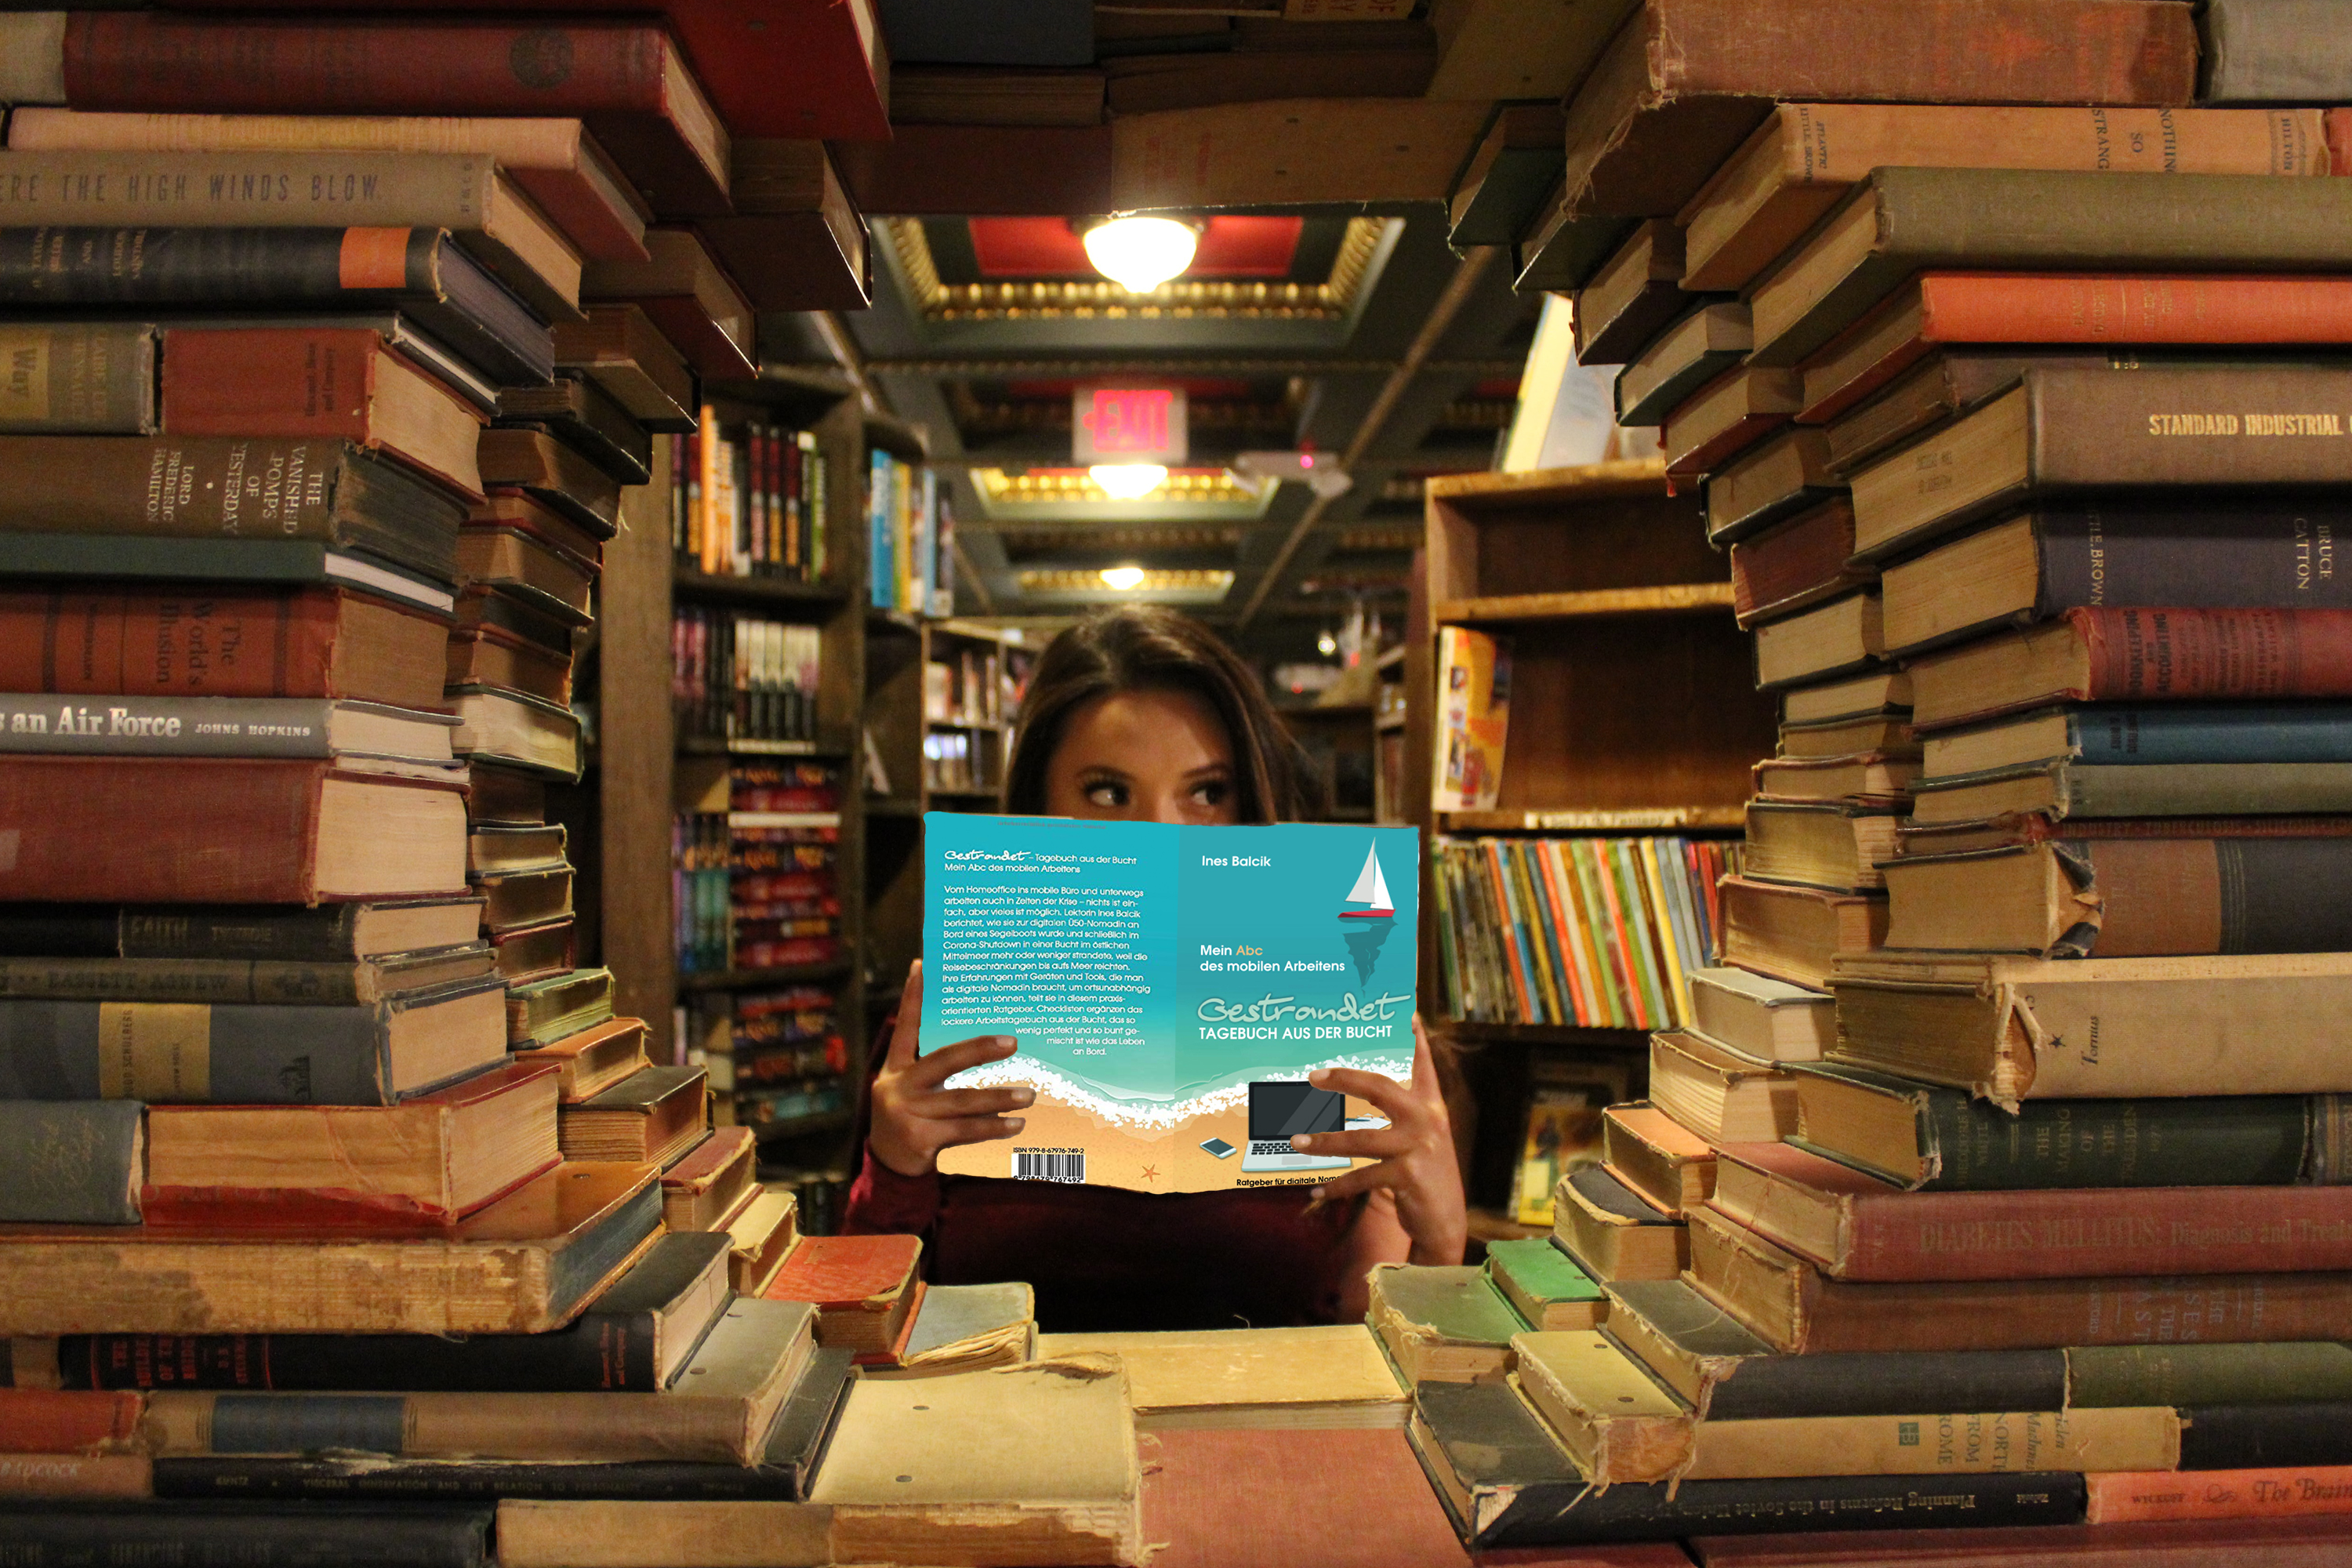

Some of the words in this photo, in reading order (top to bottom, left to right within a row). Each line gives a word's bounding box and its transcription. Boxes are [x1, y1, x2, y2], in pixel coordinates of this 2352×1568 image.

[2131, 132, 2143, 153] SO
[2281, 118, 2294, 171] HILTON
[63, 173, 106, 201] THE
[129, 173, 187, 201] HIGH
[209, 173, 289, 201] WINDS
[1093, 390, 1173, 452] EXIT
[2149, 414, 2238, 436] STANDARD
[2245, 414, 2344, 436] INDUSTRIAL
[147, 448, 167, 522] HAMILTON
[162, 451, 182, 521] FREDERIC
[179, 466, 194, 505] LORD
[223, 442, 251, 534] YESTERDAY
[246, 476, 260, 497] OF
[263, 456, 284, 519] POMPS
[283, 446, 307, 534] VANISHED
[307, 472, 323, 506] THE
[2293, 517, 2310, 590] CATTON
[2317, 524, 2333, 580] BRUCE
[2090, 549, 2104, 606] BROWN
[158, 604, 180, 682] Illusion
[189, 601, 214, 684] World's
[222, 617, 242, 665] The
[2154, 613, 2172, 692] ACCOUNTING
[10, 712, 49, 735] an
[54, 706, 103, 735] Air
[108, 706, 182, 737] Force
[194, 723, 240, 735] JOHNS
[248, 724, 311, 737] HOPKINS
[944, 850, 1032, 862] Gestrandet
[1035, 853, 1078, 863] Tagebuch
[1095, 855, 1111, 864] der
[1112, 856, 1137, 865] Bucht
[967, 863, 986, 872] Abc
[1040, 865, 1080, 873] Arbeitens
[1202, 855, 1228, 866] Ines
[1232, 855, 1272, 867] Balcik
[944, 885, 964, 894] Vom
[966, 885, 1016, 894] Homeoffice
[1029, 886, 1059, 895] mobile
[1099, 888, 1144, 898] unterwegs
[1007, 896, 1014, 905] in
[943, 919, 984, 927] berichtet,
[1029, 918, 1066, 928] digitalen
[1068, 918, 1126, 927] Ü50-Nomadin
[944, 908, 966, 916] fach,
[1025, 908, 1062, 917] möglich.
[1116, 909, 1141, 918] Balcik
[943, 930, 964, 938] Bord
[989, 929, 1036, 939] Segelboots
[1200, 945, 1232, 956] Mein
[1236, 945, 1263, 956] Abc
[1200, 960, 1223, 971] des
[1227, 960, 1280, 971] mobilen
[1283, 960, 1345, 971] Arbeitens
[1197, 992, 1411, 1022] Gestrandet
[122, 1010, 132, 1068] SCHULBERG
[1199, 1027, 1278, 1040] TAGEBUCH
[1282, 1027, 1311, 1040] AUS
[1315, 1026, 1342, 1039] DER
[1346, 1025, 1392, 1038] BUCHT
[2036, 1127, 2049, 1159] THE
[2058, 1109, 2072, 1172] MAKING
[2081, 1131, 2094, 1152] OF
[2102, 1124, 2115, 1156] THE
[1236, 1178, 1273, 1187] Ratgeber
[1919, 1221, 2034, 1253] DIABETES
[2171, 1221, 2253, 1248] Diagnosis
[2261, 1219, 2292, 1244] and
[112, 1341, 128, 1368] THE
[437, 1479, 461, 1491] AND
[2252, 1479, 2291, 1504] The
[1734, 1501, 1784, 1519] Soviet
[1789, 1500, 1814, 1515] the
[1819, 1498, 1835, 1515] in
[1840, 1496, 1904, 1514] Reforms
[1907, 1491, 1976, 1512] Planning
